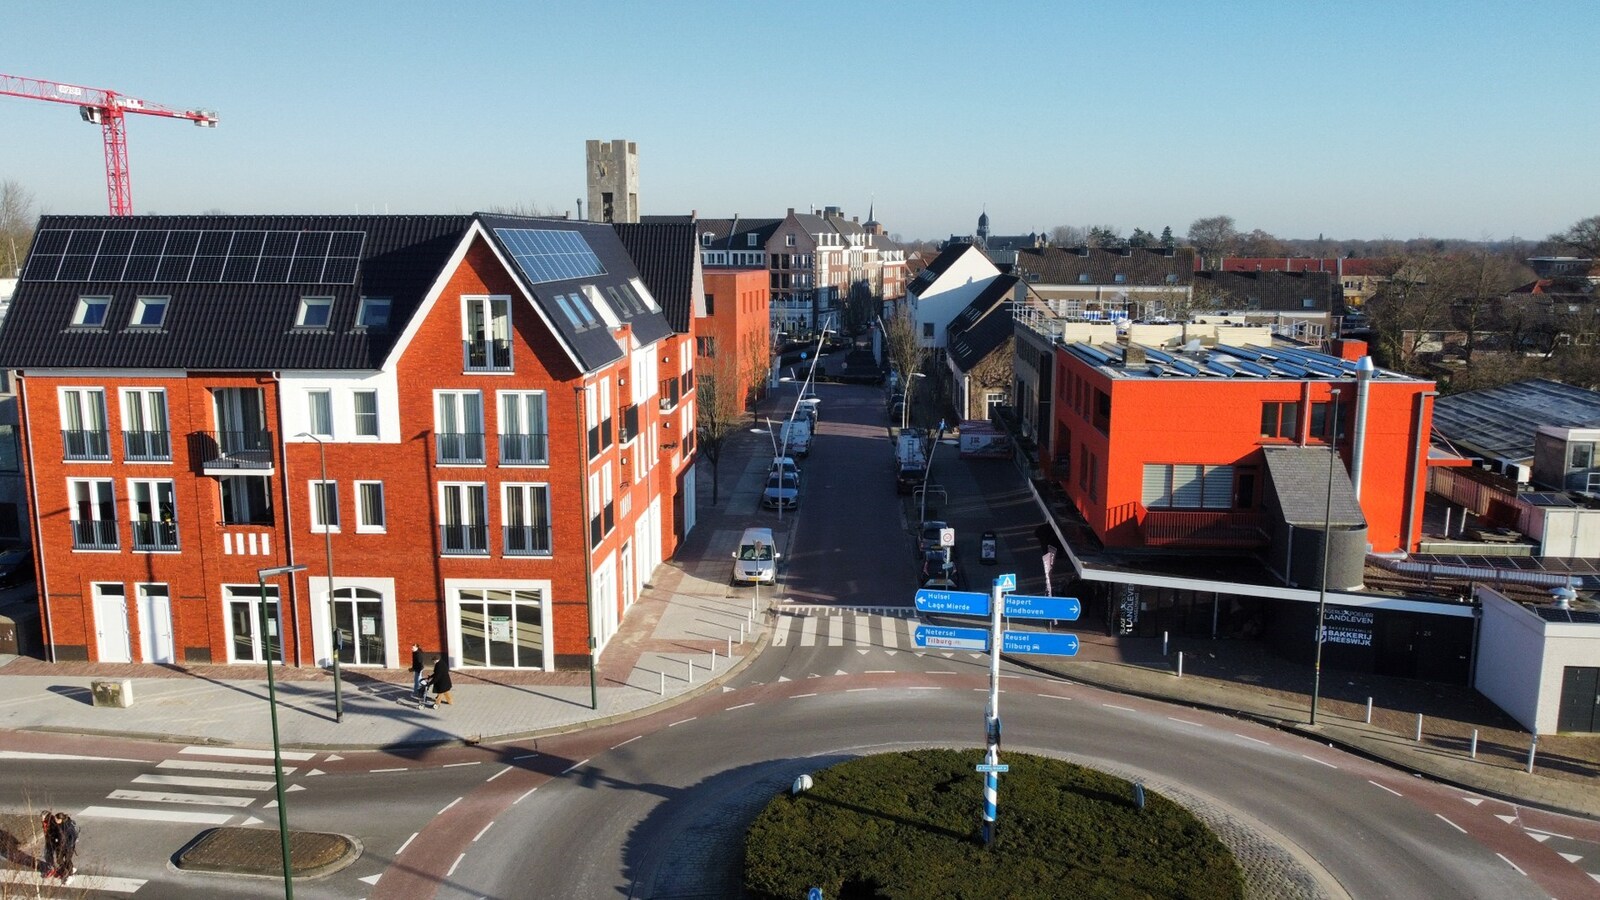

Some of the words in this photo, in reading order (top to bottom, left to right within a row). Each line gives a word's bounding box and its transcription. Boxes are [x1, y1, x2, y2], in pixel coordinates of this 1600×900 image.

[1006, 598, 1032, 606] Hapert
[1006, 607, 1044, 615] Eindhoven
[1323, 613, 1374, 624] LANDLEVEN
[925, 628, 956, 636] Netersel
[1328, 630, 1373, 640] BAKKERIJ
[1330, 636, 1371, 646] HEESWIJK
[1005, 643, 1031, 651] Tilburg
